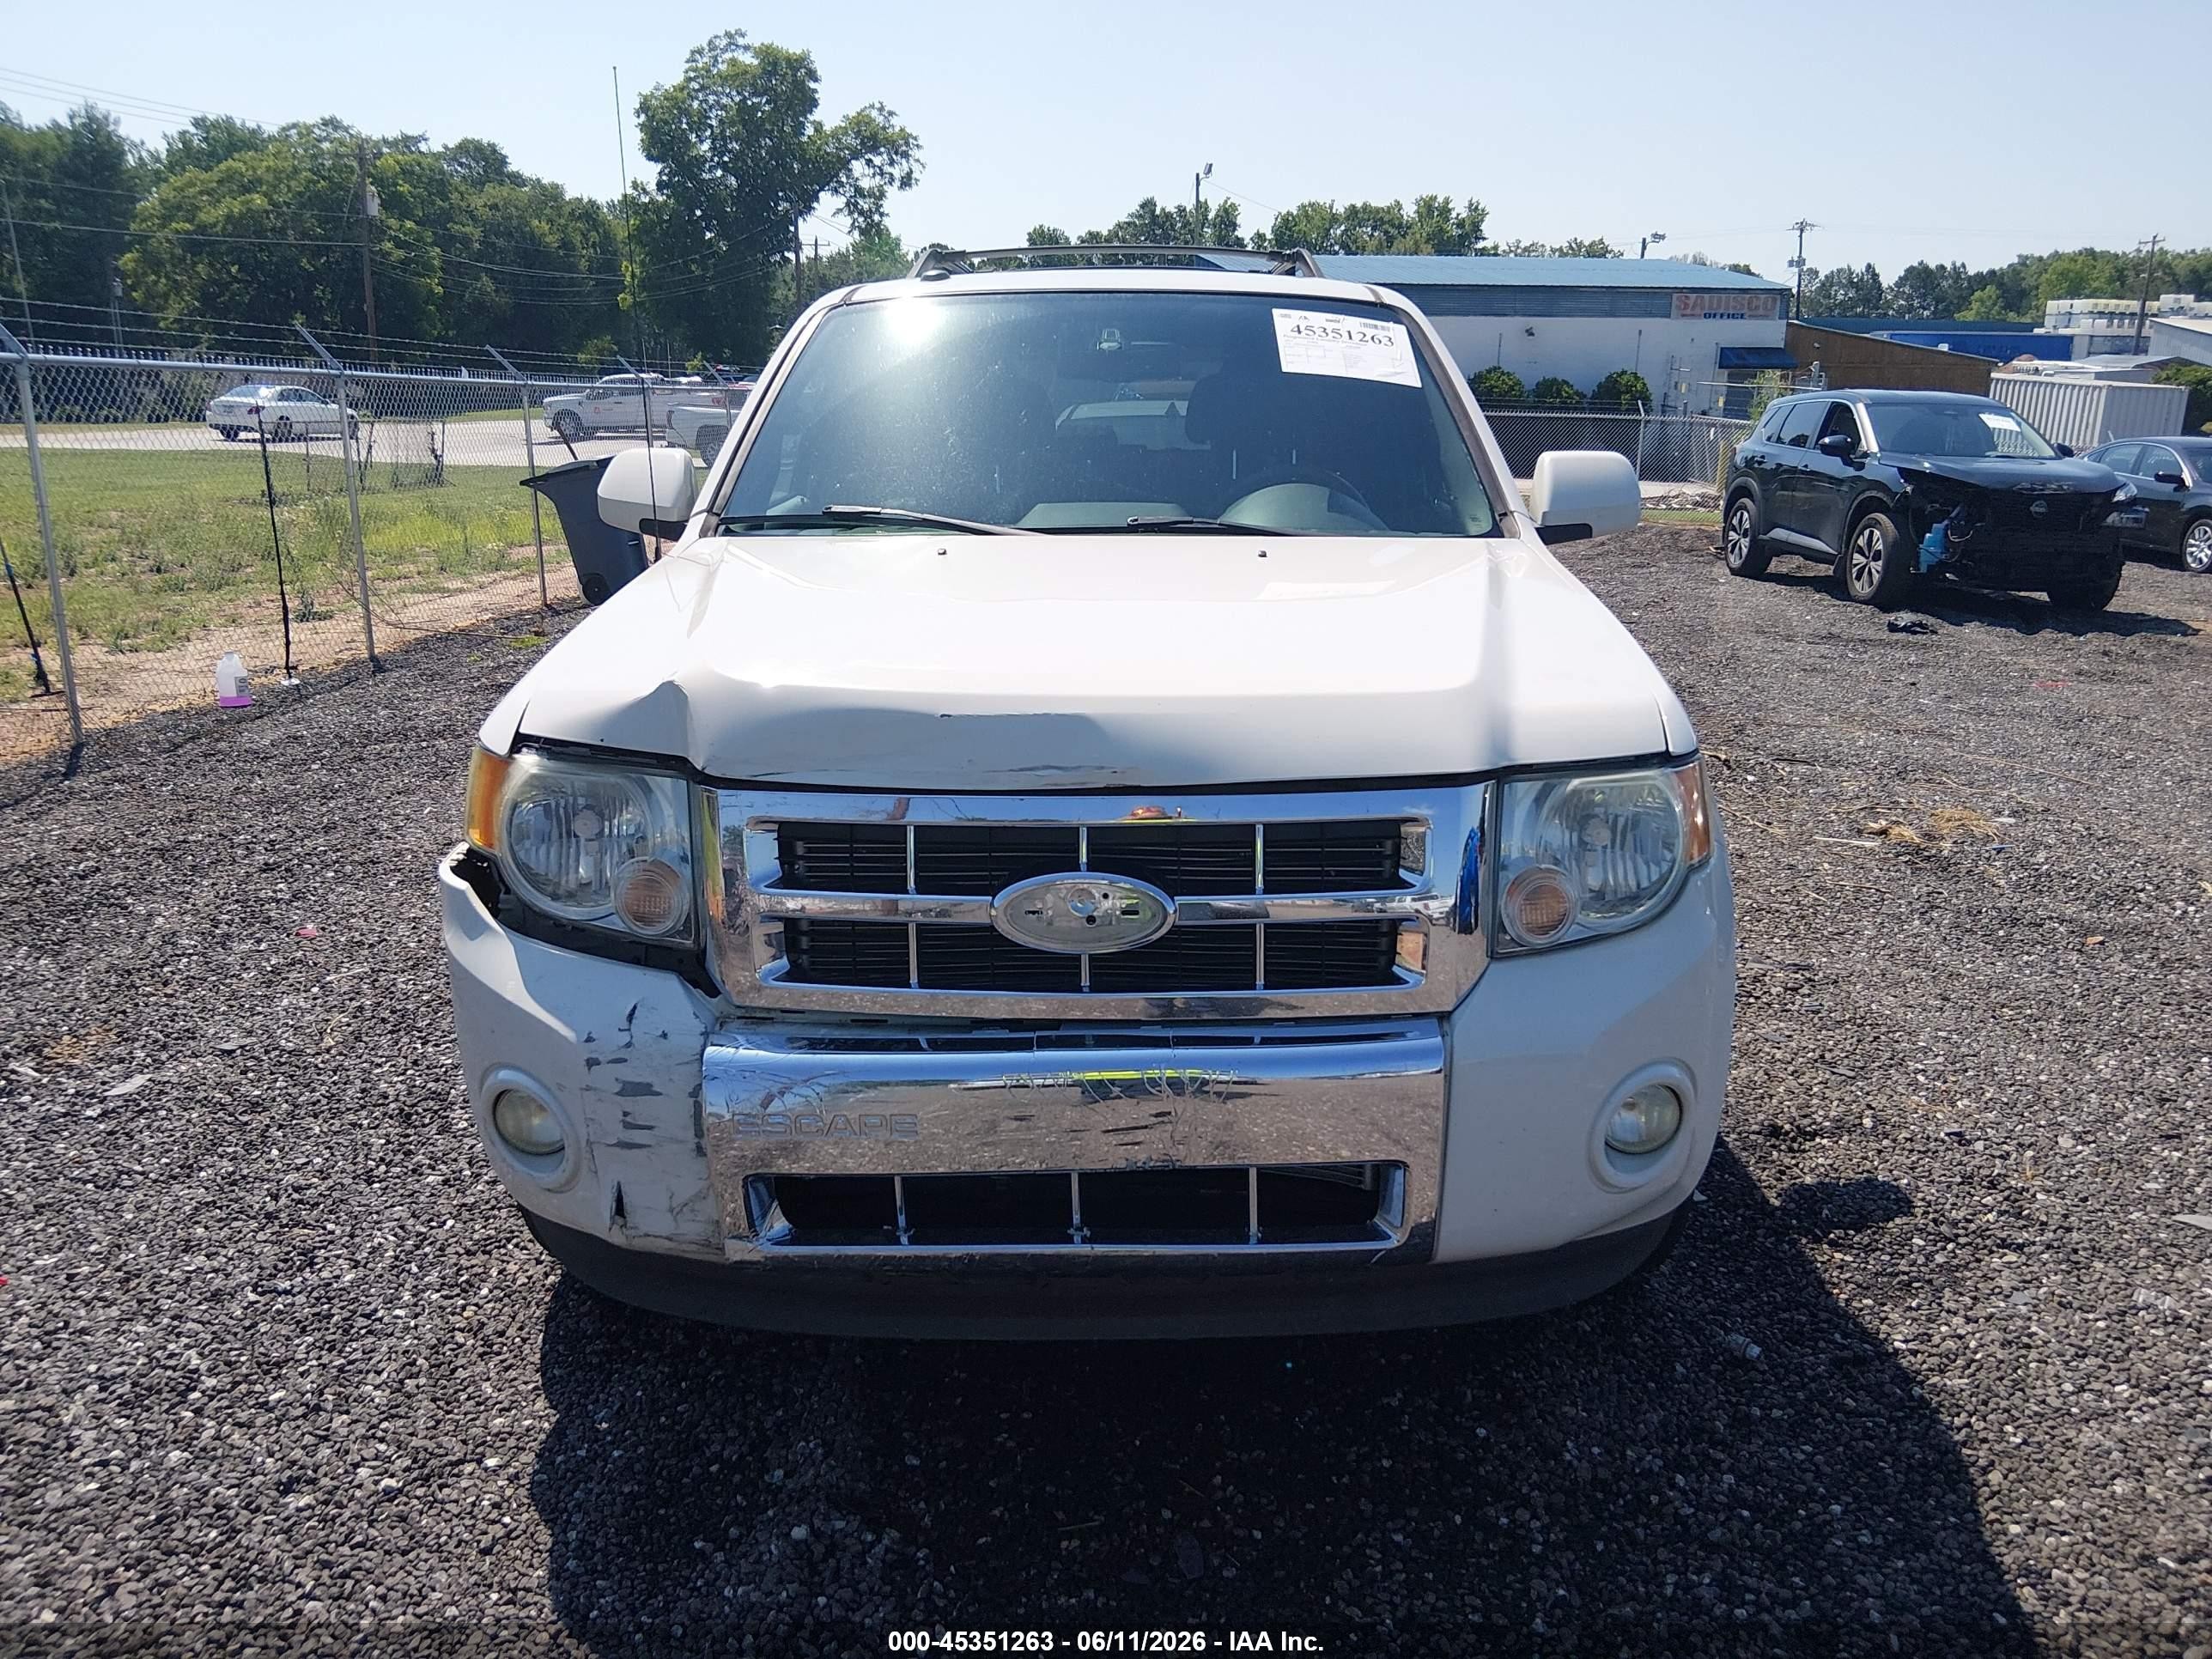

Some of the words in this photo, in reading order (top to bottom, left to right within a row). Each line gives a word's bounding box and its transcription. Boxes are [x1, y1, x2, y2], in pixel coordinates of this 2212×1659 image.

[1677, 295, 1778, 311] SADISCO
[1291, 324, 1394, 347] 45351263
[732, 1113, 919, 1139] ESCAPE
